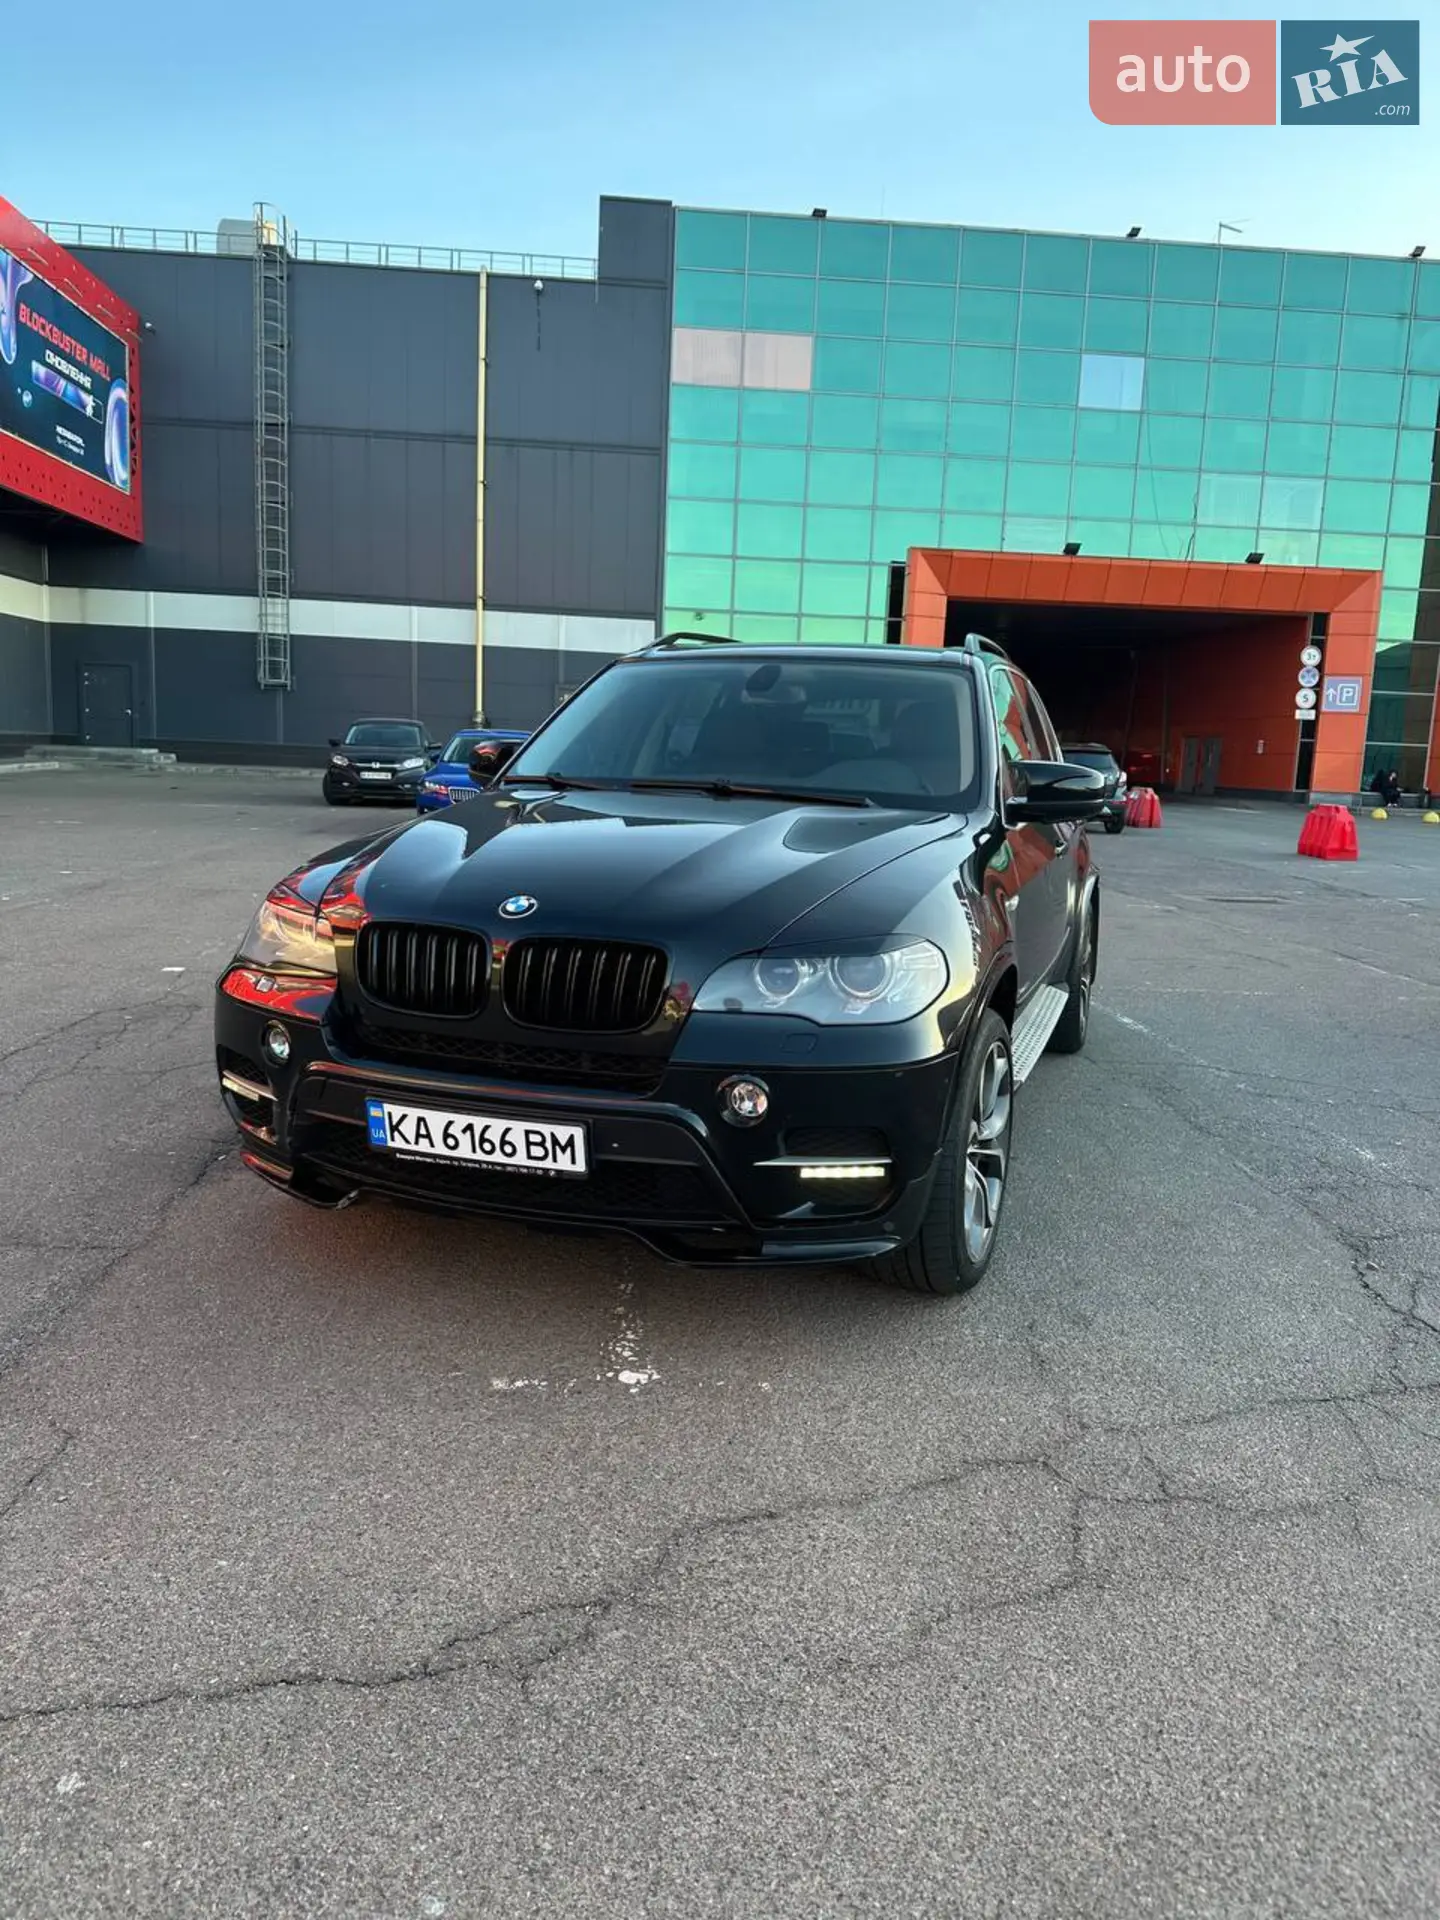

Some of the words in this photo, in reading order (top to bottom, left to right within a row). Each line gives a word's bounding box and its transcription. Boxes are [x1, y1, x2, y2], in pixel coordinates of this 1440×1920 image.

[18, 302, 88, 365] BLOCKBUSTER
[89, 353, 111, 382] MALL
[1302, 694, 1309, 703] 5
[1342, 688, 1354, 702] P
[371, 1127, 386, 1139] UA
[387, 1111, 435, 1148] KA
[442, 1120, 517, 1158] 6166
[524, 1129, 577, 1165] BM
